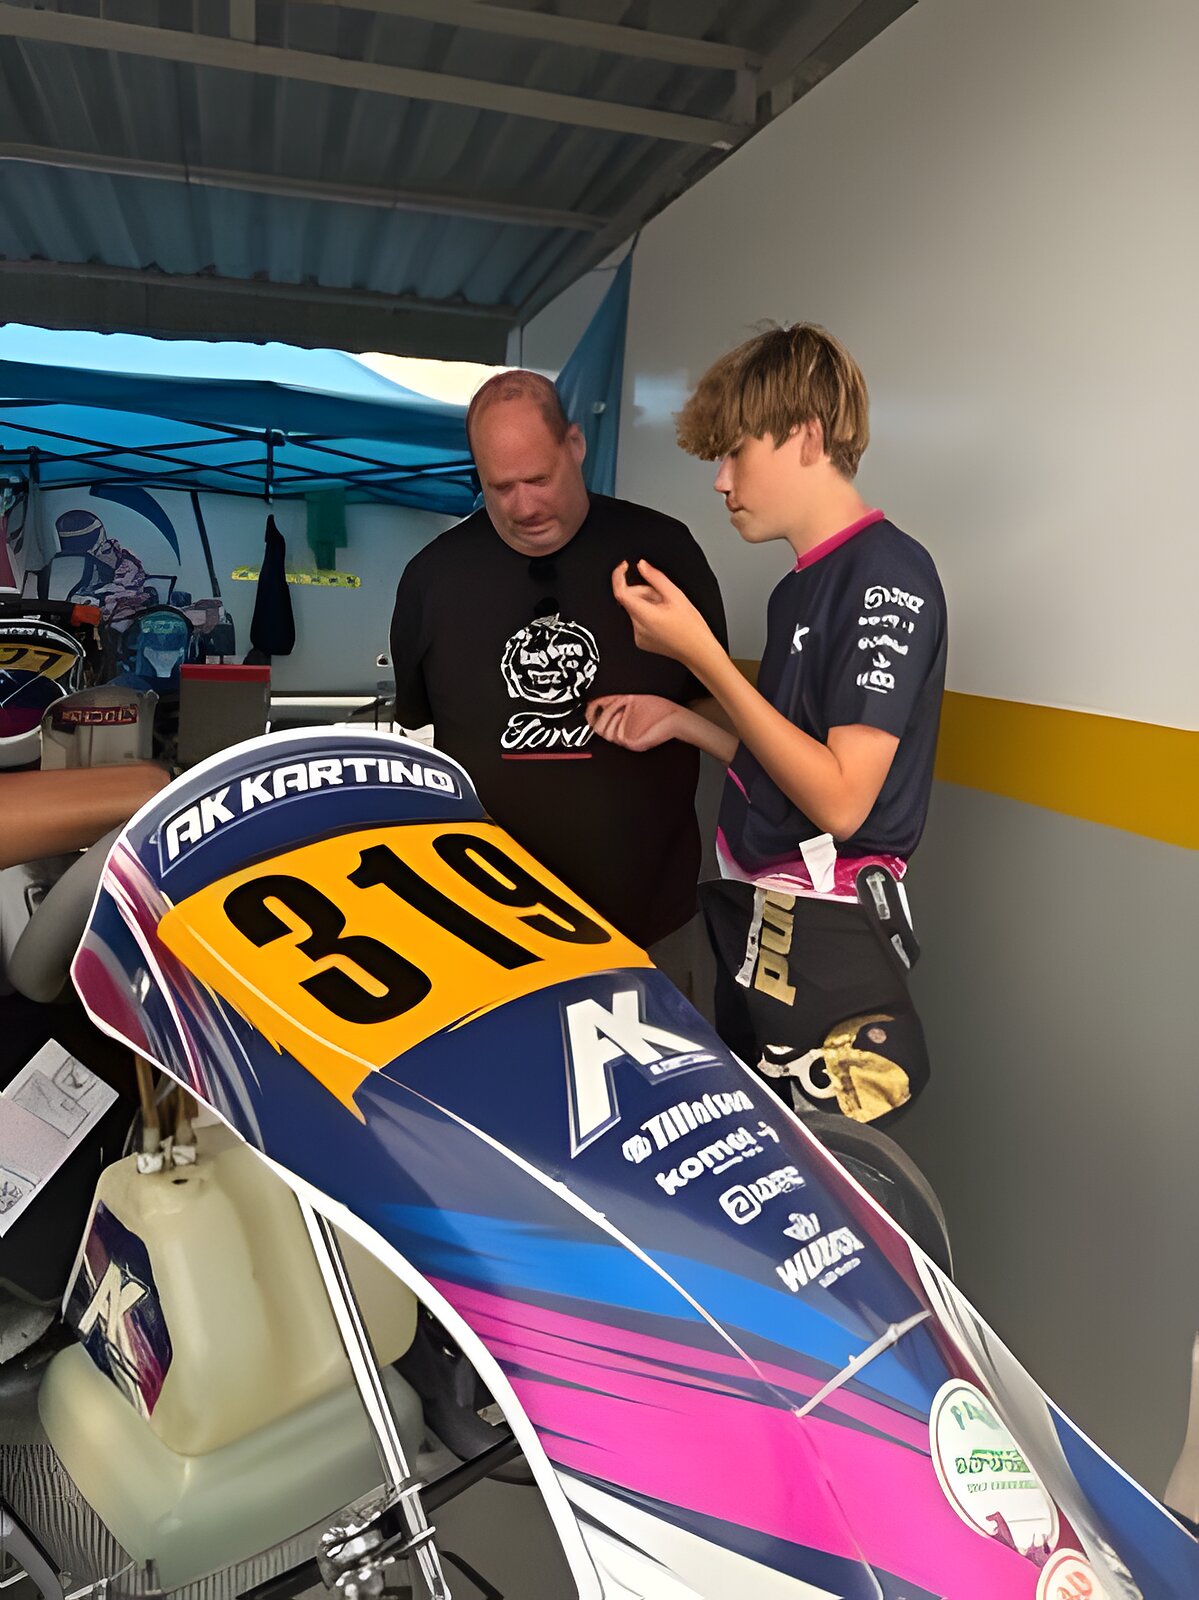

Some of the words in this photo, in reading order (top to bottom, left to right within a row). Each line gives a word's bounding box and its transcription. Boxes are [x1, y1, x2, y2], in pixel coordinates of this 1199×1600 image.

[166, 786, 236, 862] AK
[223, 833, 612, 1024] 319
[566, 990, 706, 1140] AK
